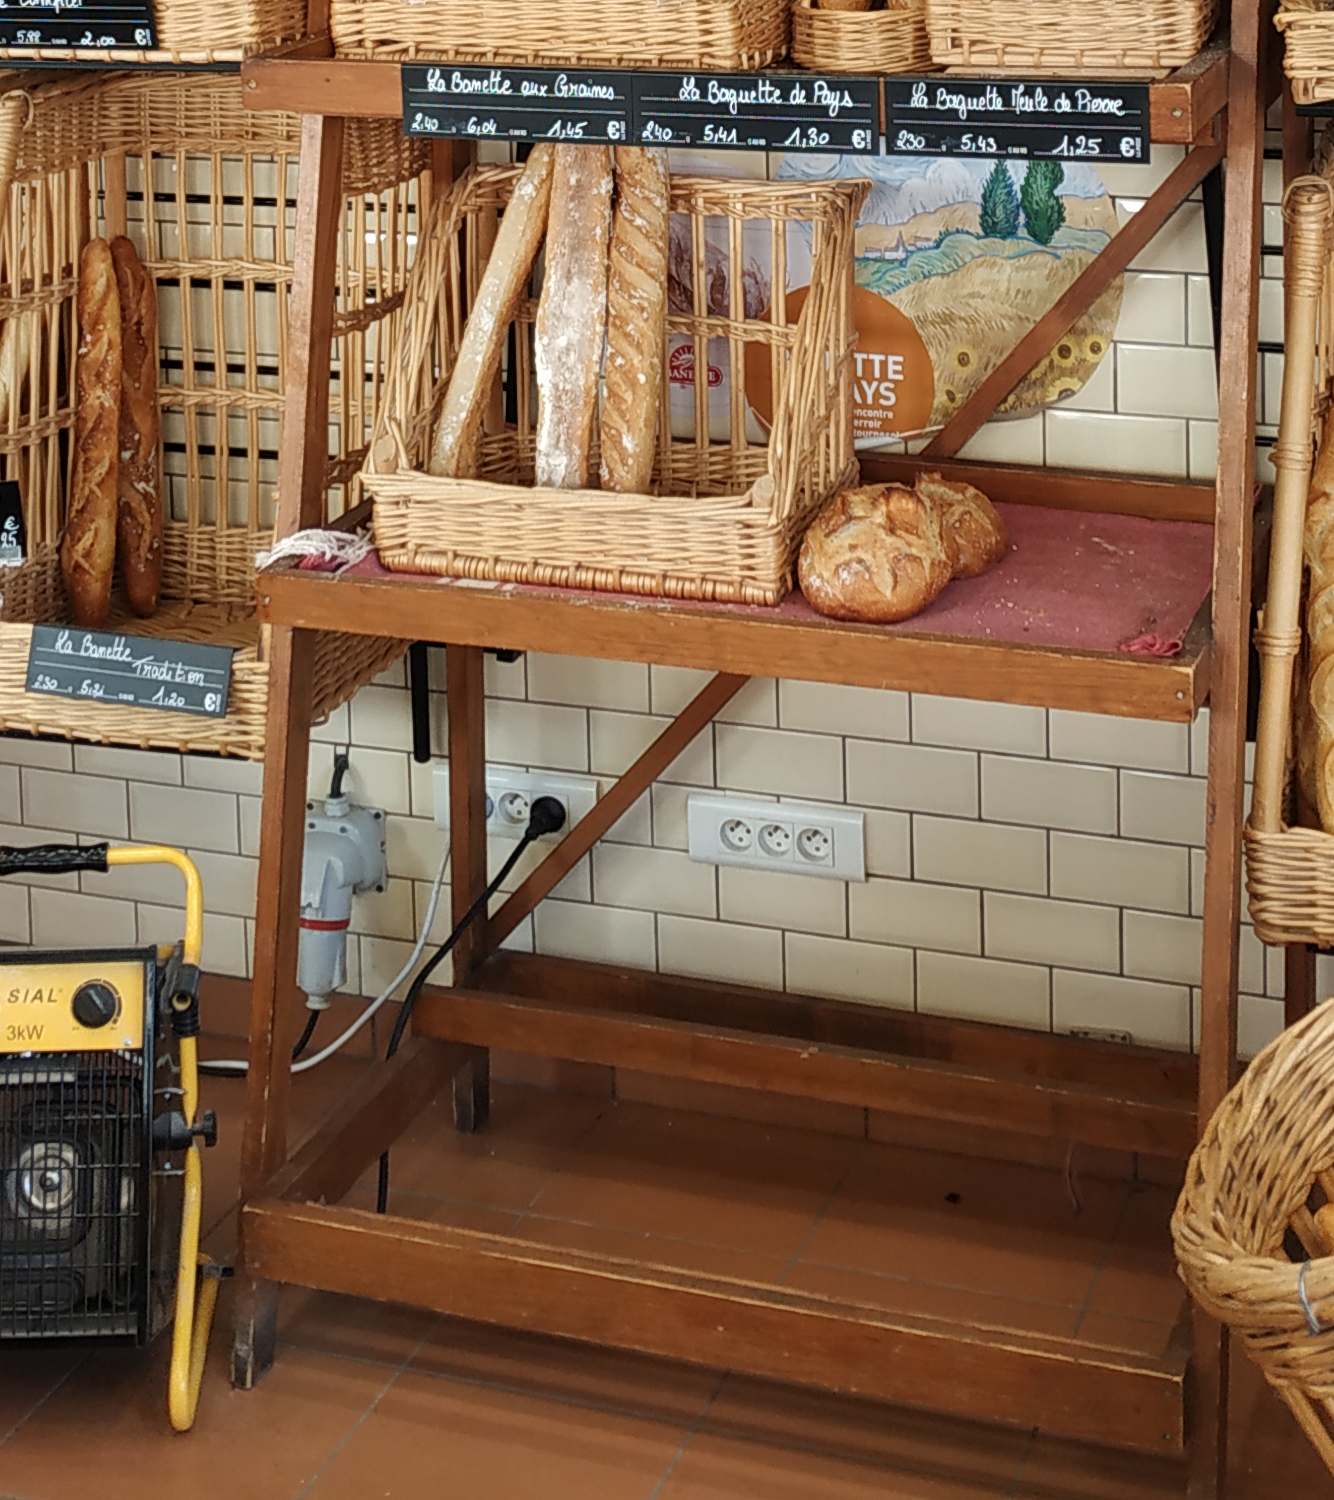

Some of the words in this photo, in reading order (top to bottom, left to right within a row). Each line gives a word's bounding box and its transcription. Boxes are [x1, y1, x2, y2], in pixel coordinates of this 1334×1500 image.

[81, 31, 116, 47] 2,00
[135, 29, 148, 45] €
[427, 68, 447, 93] La
[451, 70, 513, 95] Banette
[521, 80, 548, 97] aux
[555, 73, 615, 100] Graines
[679, 76, 700, 102] La
[708, 79, 783, 115] Baguette
[789, 83, 807, 105] de
[813, 80, 854, 117] Pays
[910, 82, 928, 108] La
[936, 85, 1004, 119] Baguette
[1054, 93, 1072, 113] de
[546, 119, 588, 140] 1,45
[607, 121, 620, 140] €
[642, 120, 673, 140] 240
[704, 124, 737, 145] 5,41
[784, 127, 830, 148] 1,30
[851, 130, 866, 149] €
[897, 130, 926, 150] 230
[960, 134, 997, 152] 5,43
[1052, 135, 1102, 156] 1,25
[1119, 137, 1135, 157] €
[55, 630, 73, 654] La
[80, 634, 132, 662] Banette
[132, 655, 205, 686] Tradition
[152, 685, 186, 707] 1,20
[204, 693, 218, 711] €
[7, 989, 58, 1004] SIAL
[6, 1025, 44, 1041] 3kW
